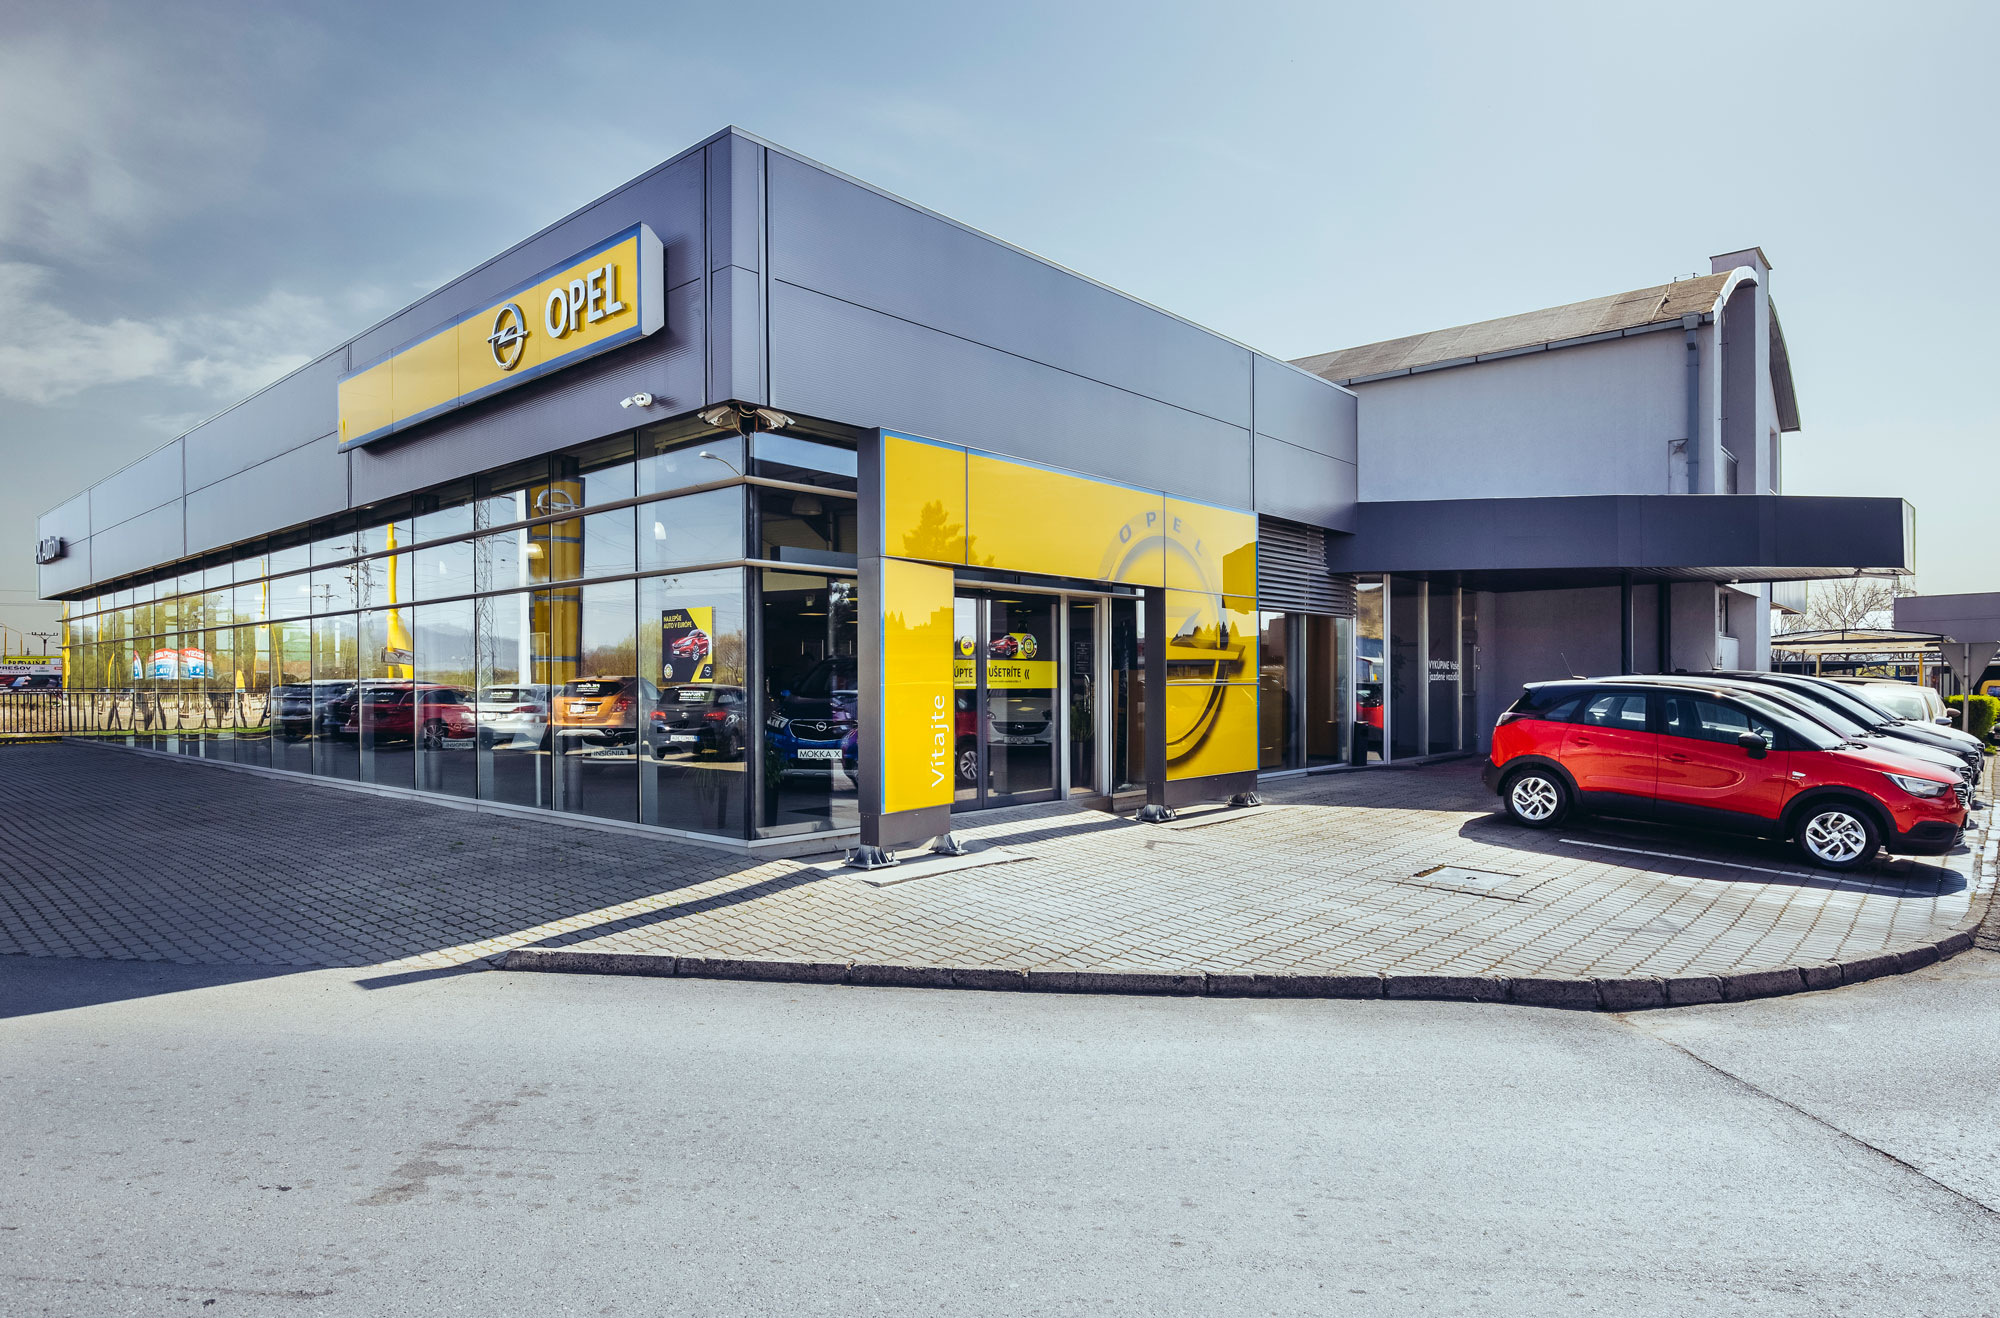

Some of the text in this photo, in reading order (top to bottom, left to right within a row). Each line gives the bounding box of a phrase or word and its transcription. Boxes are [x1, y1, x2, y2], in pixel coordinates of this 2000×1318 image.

[545, 263, 624, 338] OPEL
[1119, 511, 1202, 557] OPEL
[663, 613, 682, 622] NAJLEPŠIE
[677, 619, 693, 629] EURÓPE
[954, 665, 1022, 678] ÚPTE UŠETRÍTE
[930, 695, 950, 788] Vítajte
[799, 750, 841, 758] MOKKA X
